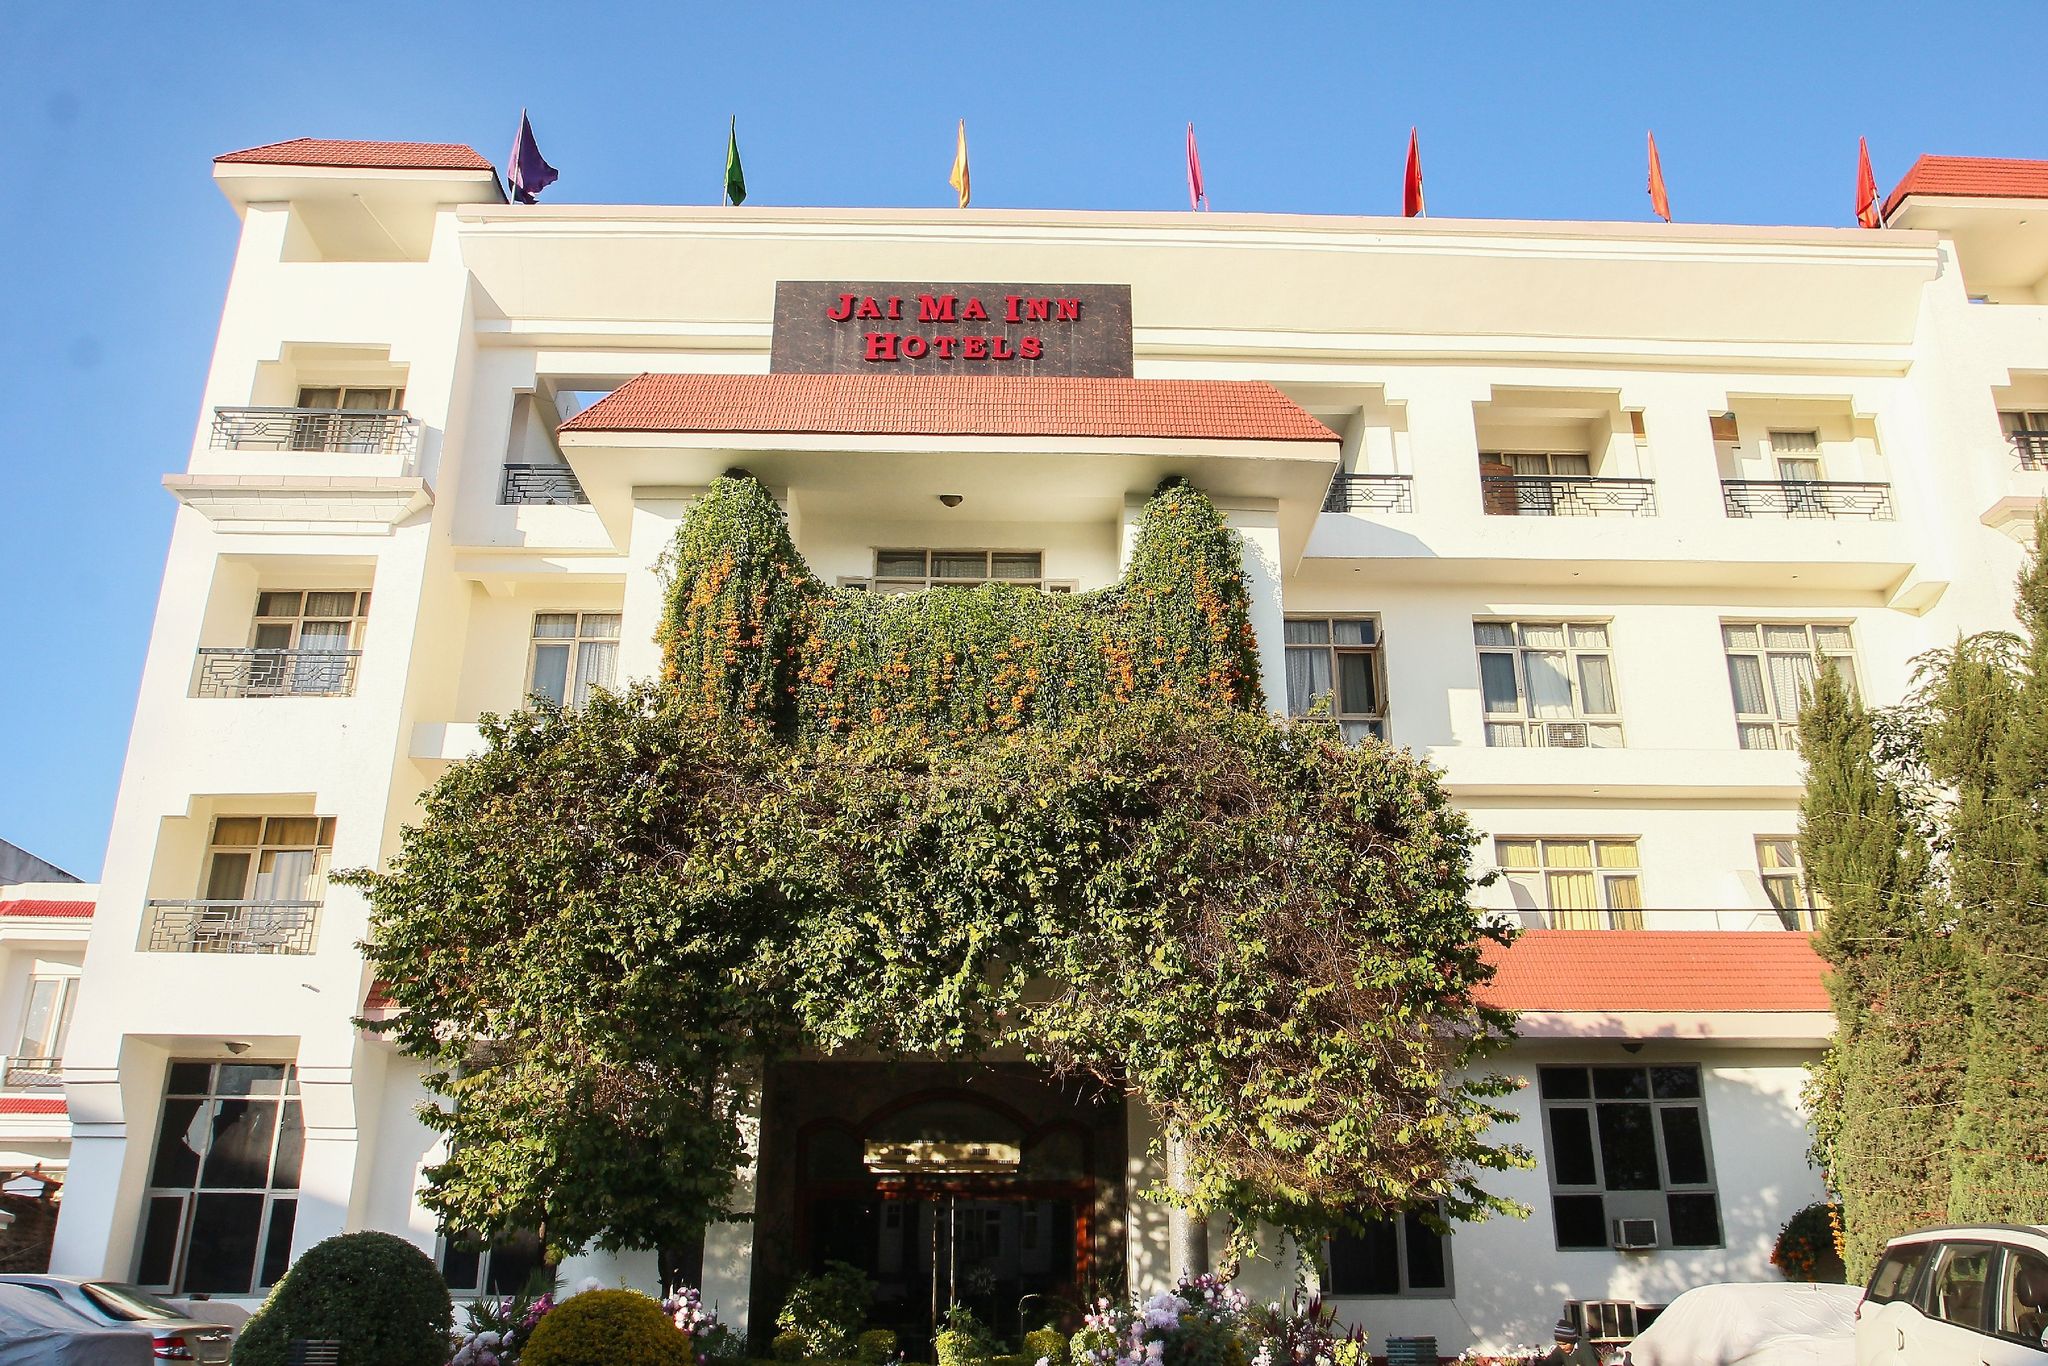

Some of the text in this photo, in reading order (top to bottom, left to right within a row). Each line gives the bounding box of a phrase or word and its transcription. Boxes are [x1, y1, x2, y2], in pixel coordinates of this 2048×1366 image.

[827, 294, 1081, 324] JAI MA INN
[864, 332, 1043, 361] HOTELS
